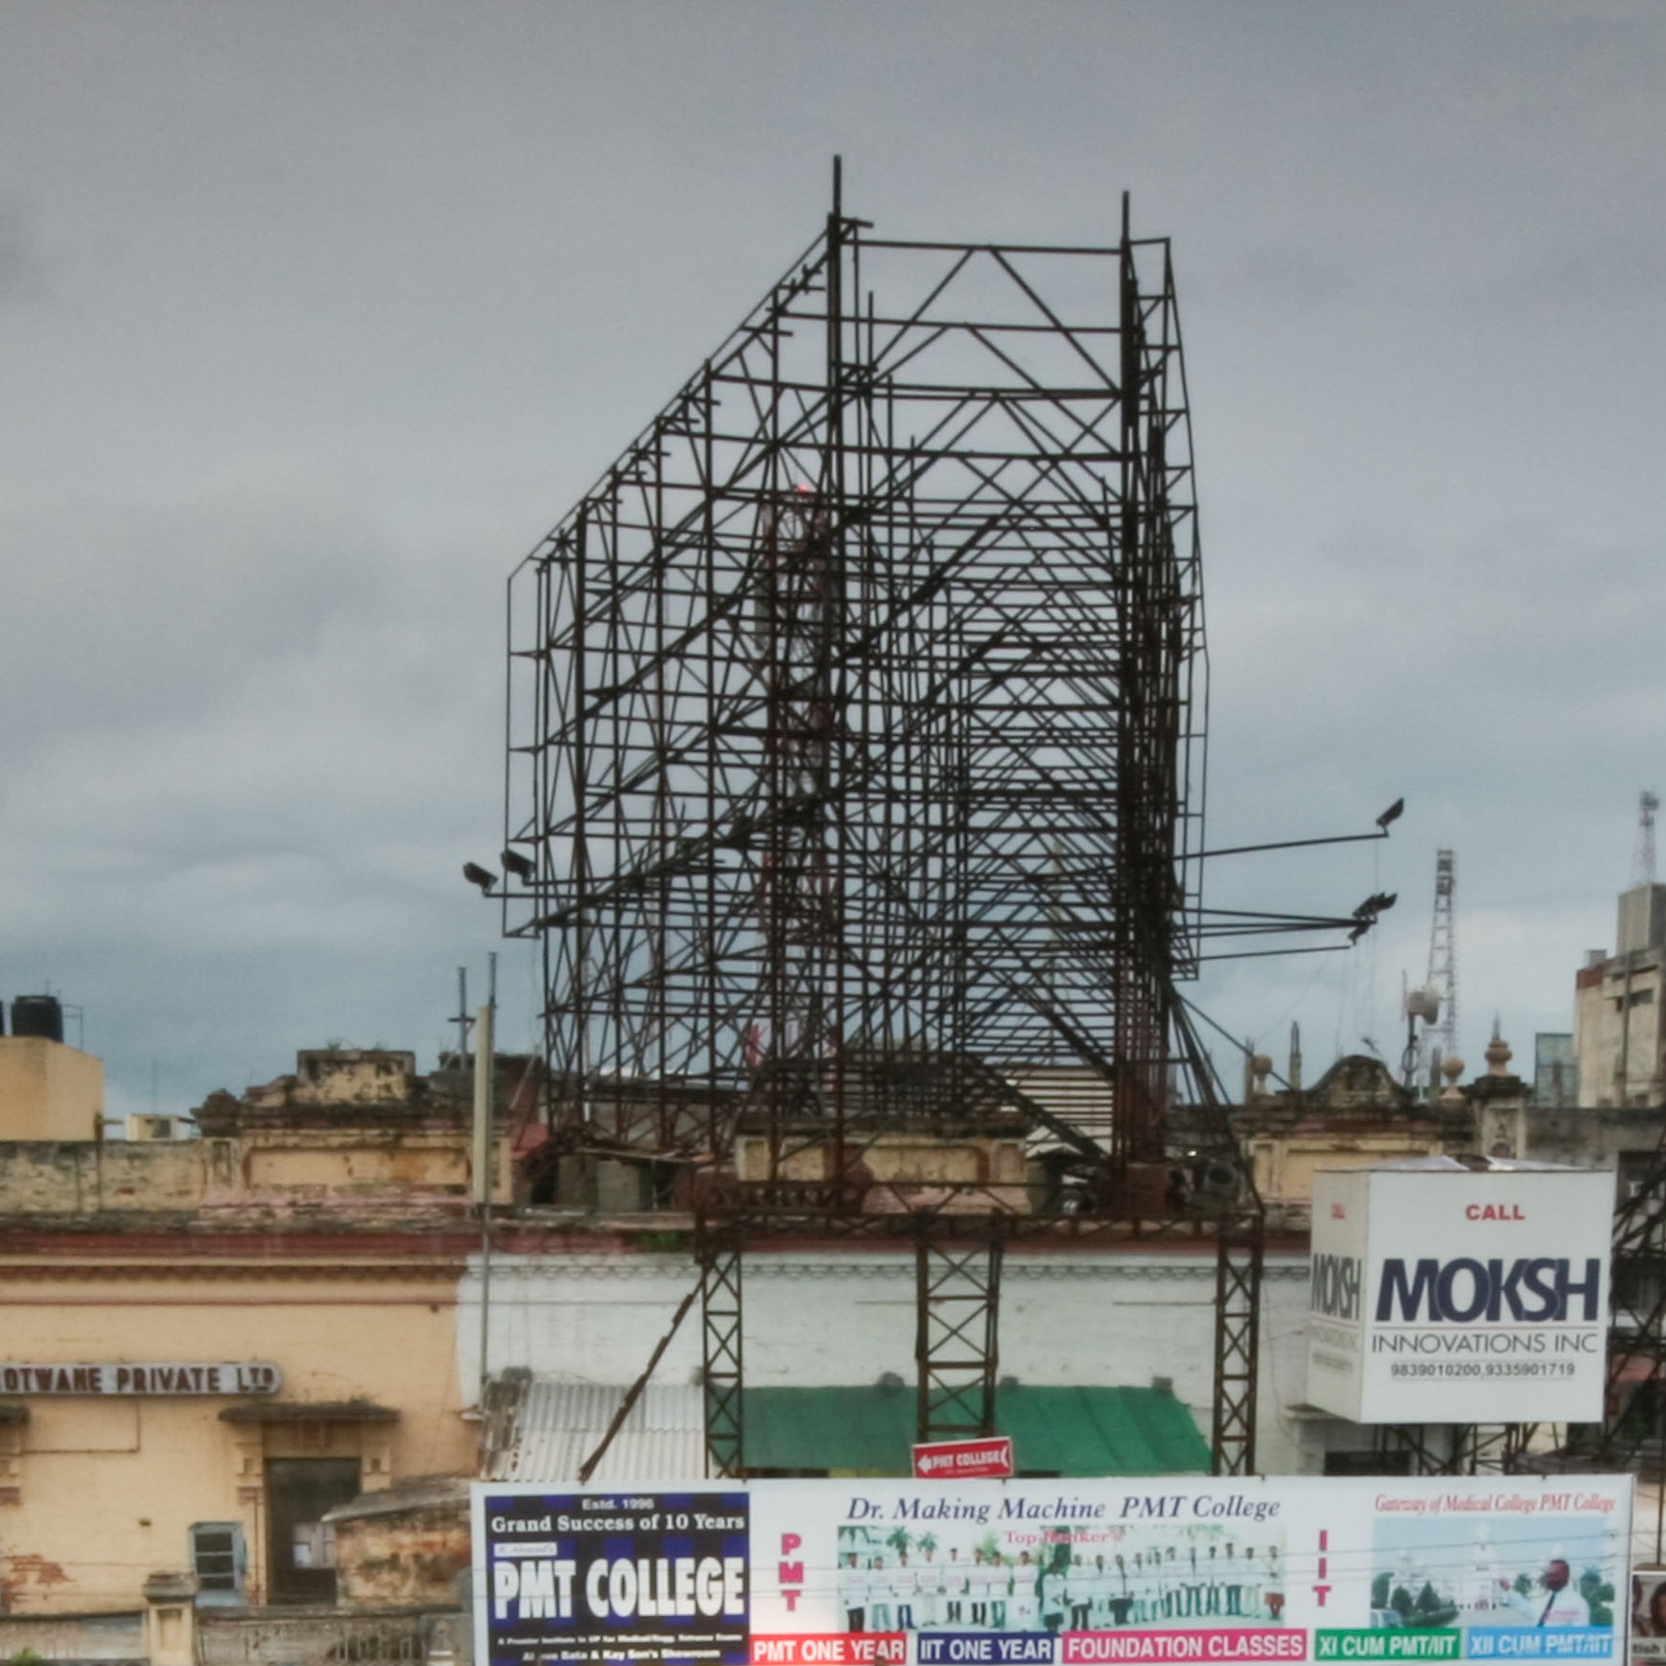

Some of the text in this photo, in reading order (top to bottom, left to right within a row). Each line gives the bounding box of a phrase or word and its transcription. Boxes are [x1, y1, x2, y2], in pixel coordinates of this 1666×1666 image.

[1465, 1204, 1525, 1221] CALL
[1311, 1253, 1361, 1321] MOKSH
[1375, 1257, 1601, 1322] MOKSH
[1371, 1333, 1545, 1355] INNOVATIONS
[1554, 1333, 1598, 1354] INC
[117, 1367, 220, 1392] PRIVATE
[236, 1367, 274, 1392] LTD
[956, 1450, 1000, 1467] COLLEGE
[847, 1496, 1281, 1524] Dr. Making Machine PMT College
[1540, 1494, 1572, 1511] PMT
[491, 1513, 745, 1533] Grand Success of 10 Years
[1003, 1531, 1036, 1546] Top
[494, 1557, 744, 1619] PMT COLLEGE
[754, 1638, 903, 1663] PMT ONE YEAR
[921, 1638, 1052, 1661] IIT ONE YEAR
[1068, 1634, 1303, 1660] FOUNDATION CLASSES
[1319, 1634, 1457, 1657] XI CUM PMT/IIT
[1470, 1636, 1494, 1655] XII
[1505, 1635, 1543, 1655] CUM
